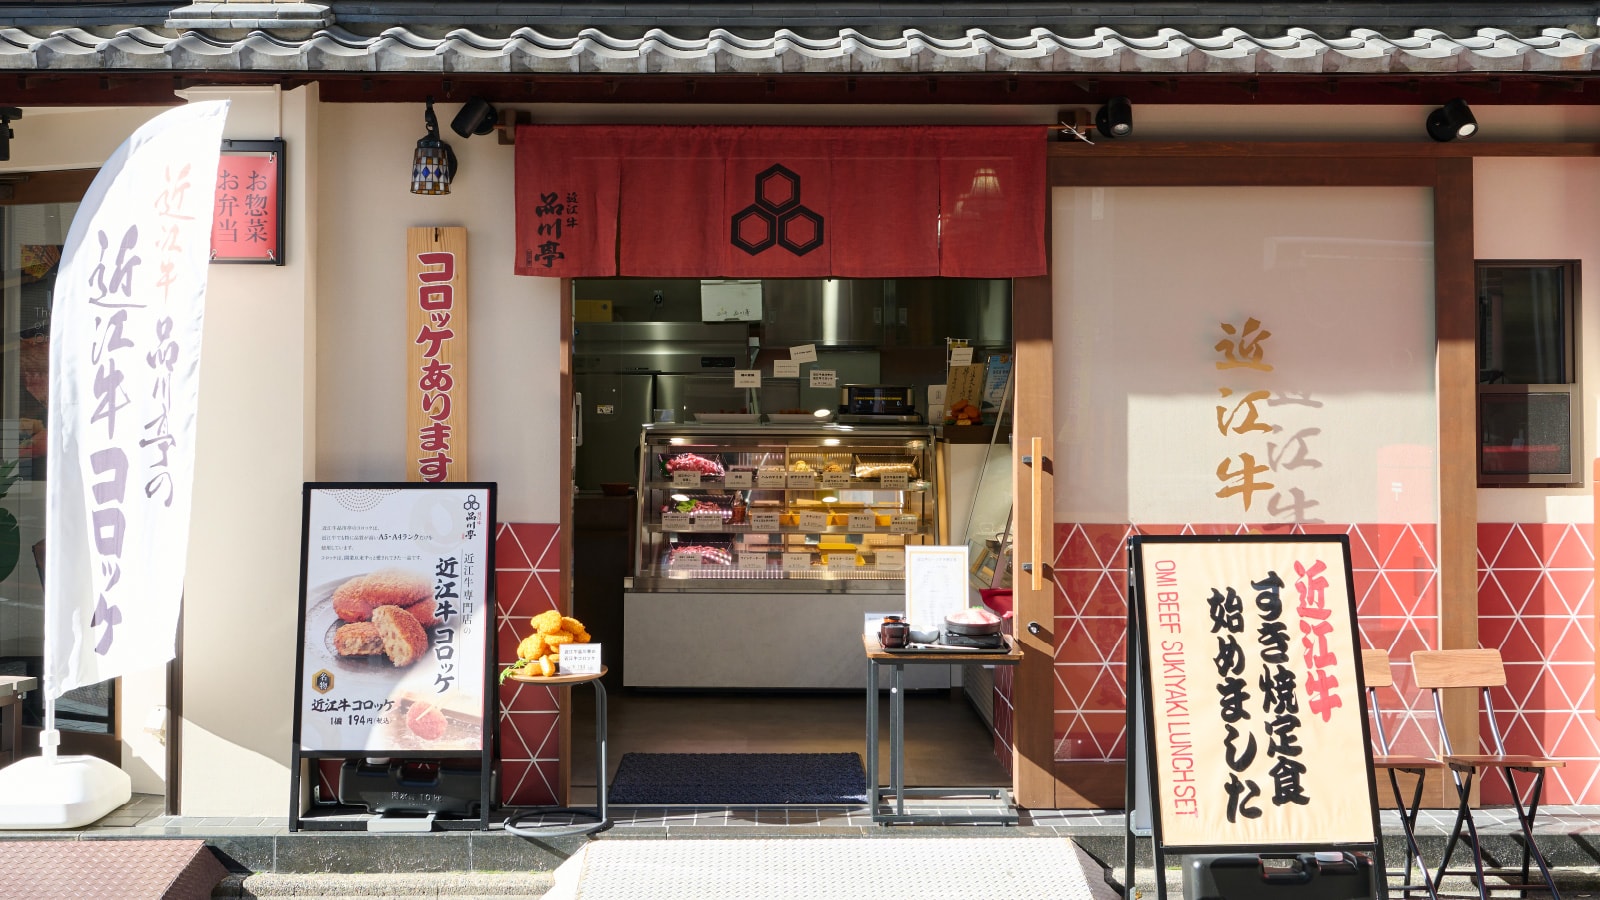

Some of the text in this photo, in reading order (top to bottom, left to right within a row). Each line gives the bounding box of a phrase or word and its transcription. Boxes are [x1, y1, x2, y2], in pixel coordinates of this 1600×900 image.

[217, 169, 240, 243] お弁当
[244, 169, 269, 243] お惣菜
[534, 191, 566, 268] 品川亭
[566, 192, 579, 229] 近江牛
[139, 162, 195, 508] 近江牛 品川亭の
[415, 251, 455, 483] コロッケあります
[88, 223, 147, 656] 近江牛コロッケ
[1214, 316, 1275, 512] 近江牛
[464, 511, 478, 541] 品川亭
[462, 553, 475, 635] 近江牛専門店の
[1155, 560, 1177, 587] OMI
[1157, 591, 1182, 634] BEEF
[434, 556, 460, 694] 近江牛コロッケ
[1294, 559, 1342, 722] 近江牛
[311, 698, 396, 713] 近江牛コロッケ
[318, 672, 329, 691] 名物
[1161, 640, 1190, 718] SUKIYAKI
[1206, 586, 1263, 824] 始めました
[1250, 570, 1310, 807] すき焼定食
